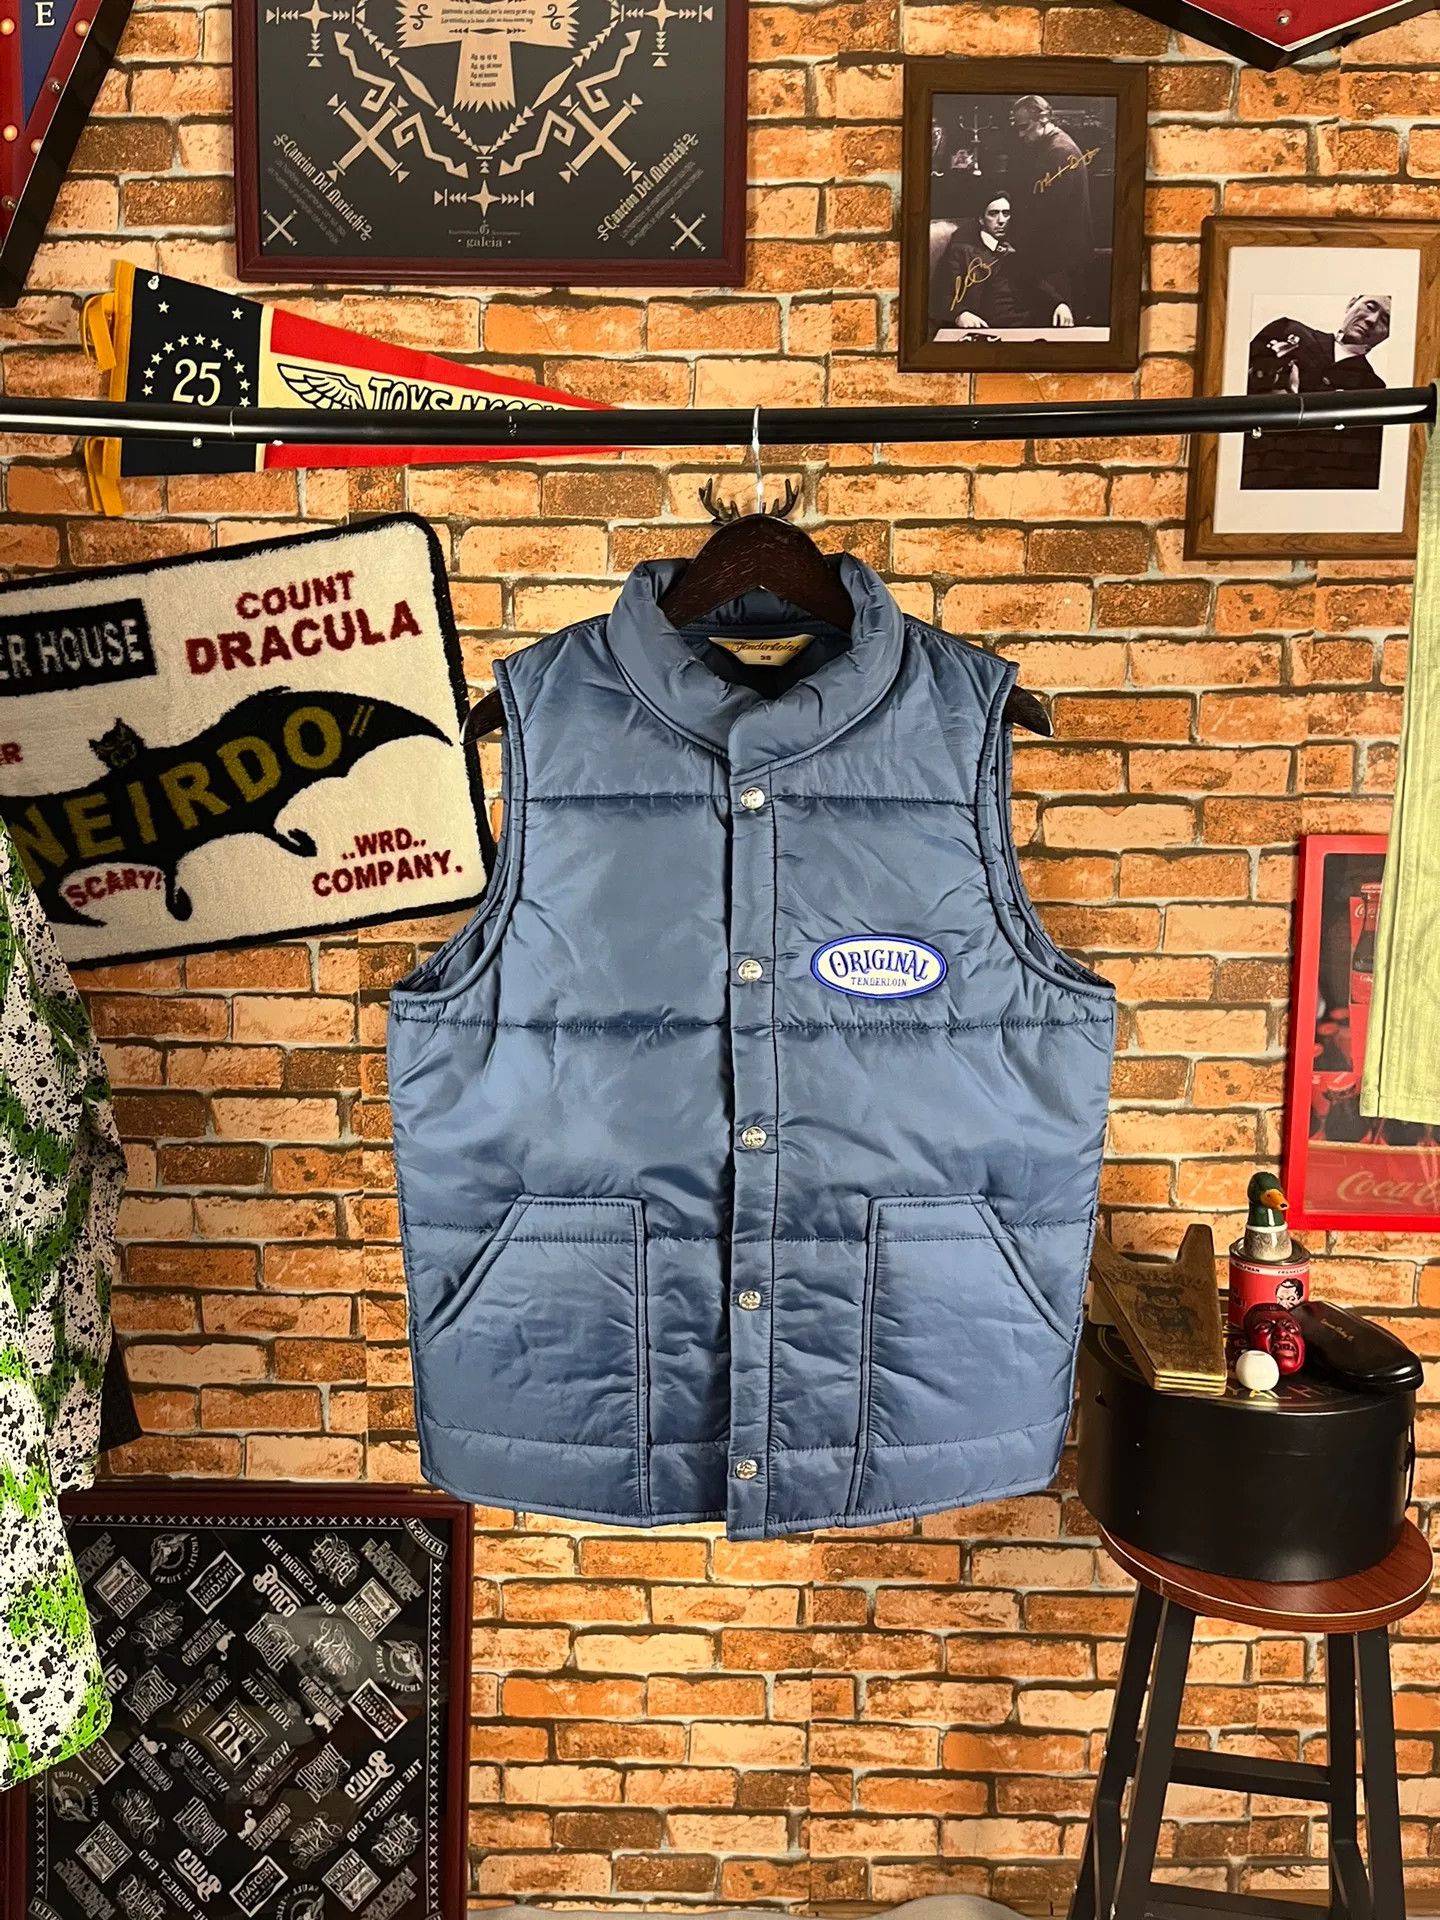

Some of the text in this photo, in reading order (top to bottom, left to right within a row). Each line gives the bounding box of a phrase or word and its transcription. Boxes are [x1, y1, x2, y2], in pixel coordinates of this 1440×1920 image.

[35, 1, 55, 27] E
[313, 171, 334, 193] Del
[633, 174, 655, 199] Del
[172, 358, 222, 407] 25
[235, 570, 355, 620] COUNT
[35, 617, 145, 675] HOUSE
[184, 599, 422, 676] DRACULA
[64, 867, 162, 907] SCARY!
[828, 949, 930, 982] ORIGINAL
[850, 976, 908, 988] TENDERLOIN
